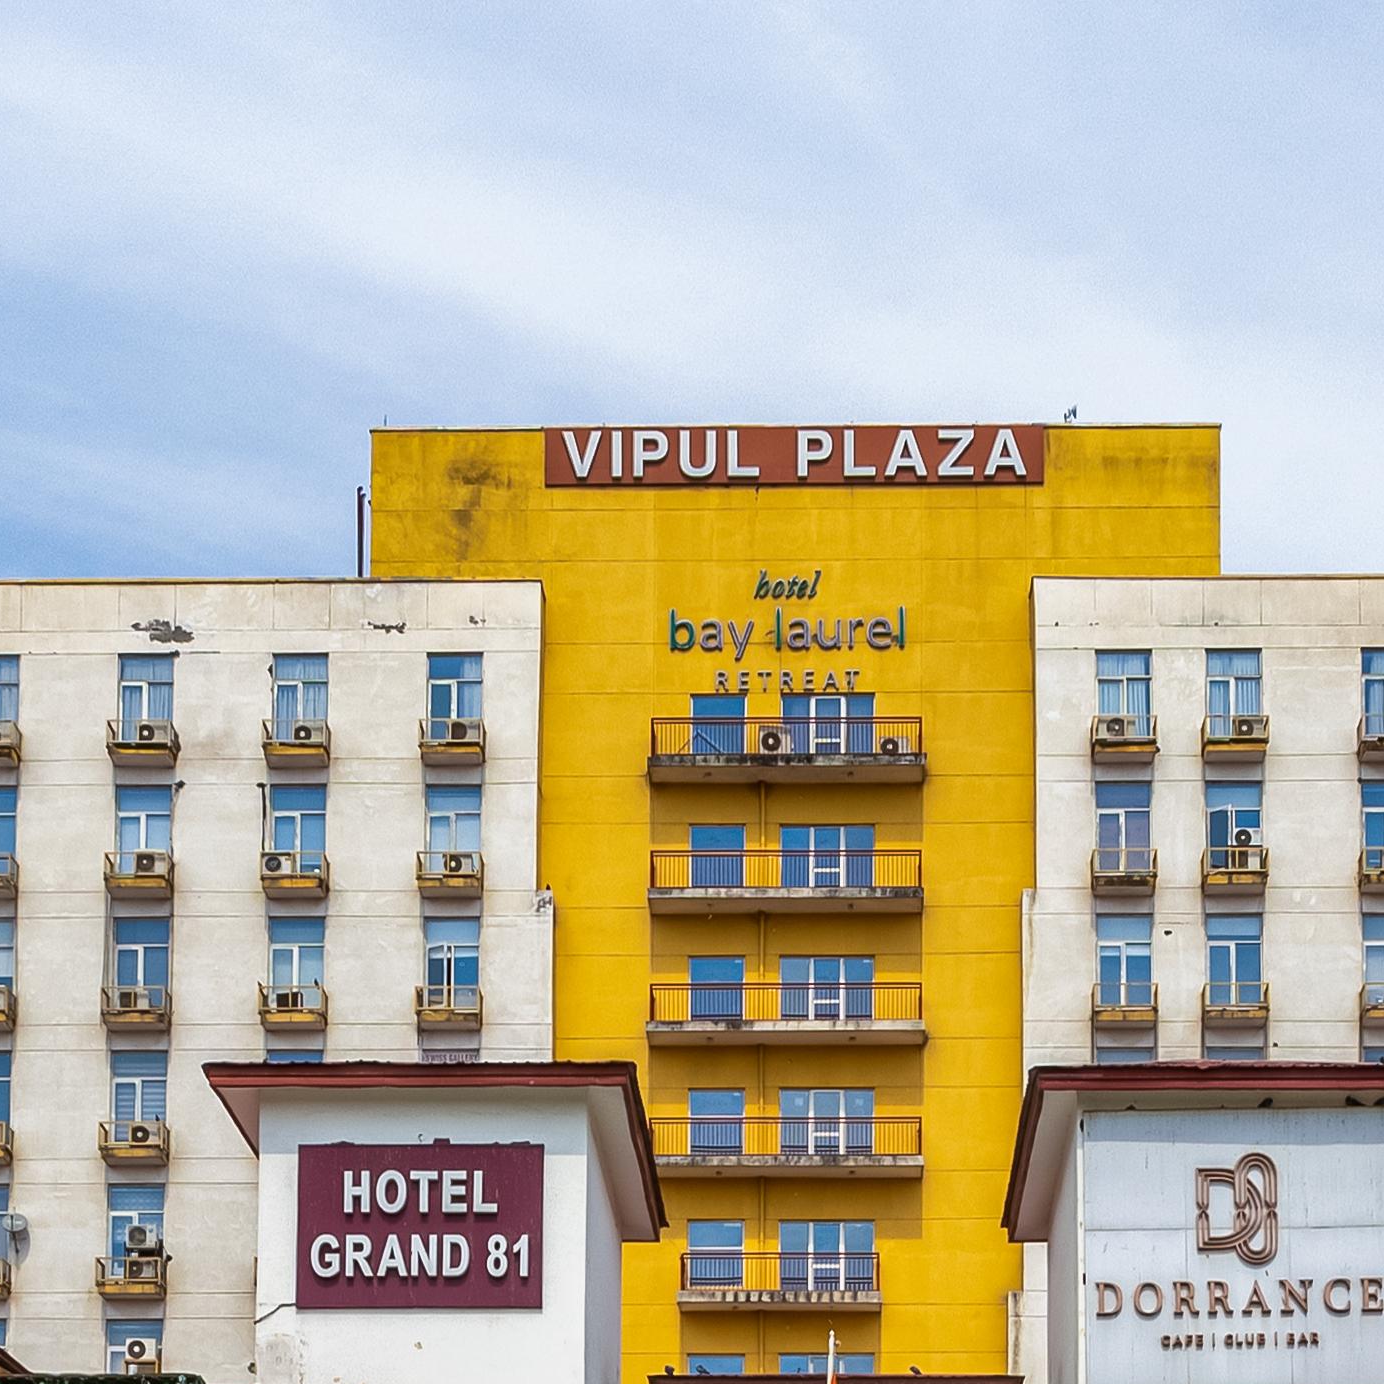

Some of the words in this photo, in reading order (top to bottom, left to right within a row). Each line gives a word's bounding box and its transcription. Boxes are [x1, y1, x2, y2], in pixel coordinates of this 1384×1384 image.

[562, 428, 761, 479] VIPUL
[797, 428, 1028, 477] PLAZA
[753, 569, 822, 601] hotel
[668, 608, 755, 661] bay
[774, 606, 906, 651] laurel
[714, 669, 861, 693] RETREAT
[343, 1170, 499, 1214] HOTEL
[310, 1233, 470, 1278] GRAND
[486, 1233, 530, 1278] 81
[1094, 1277, 1384, 1318] DORRANCE
[1160, 1334, 1204, 1349] CAFE
[1223, 1333, 1267, 1348] CLUB
[1286, 1332, 1321, 1347] BAR
